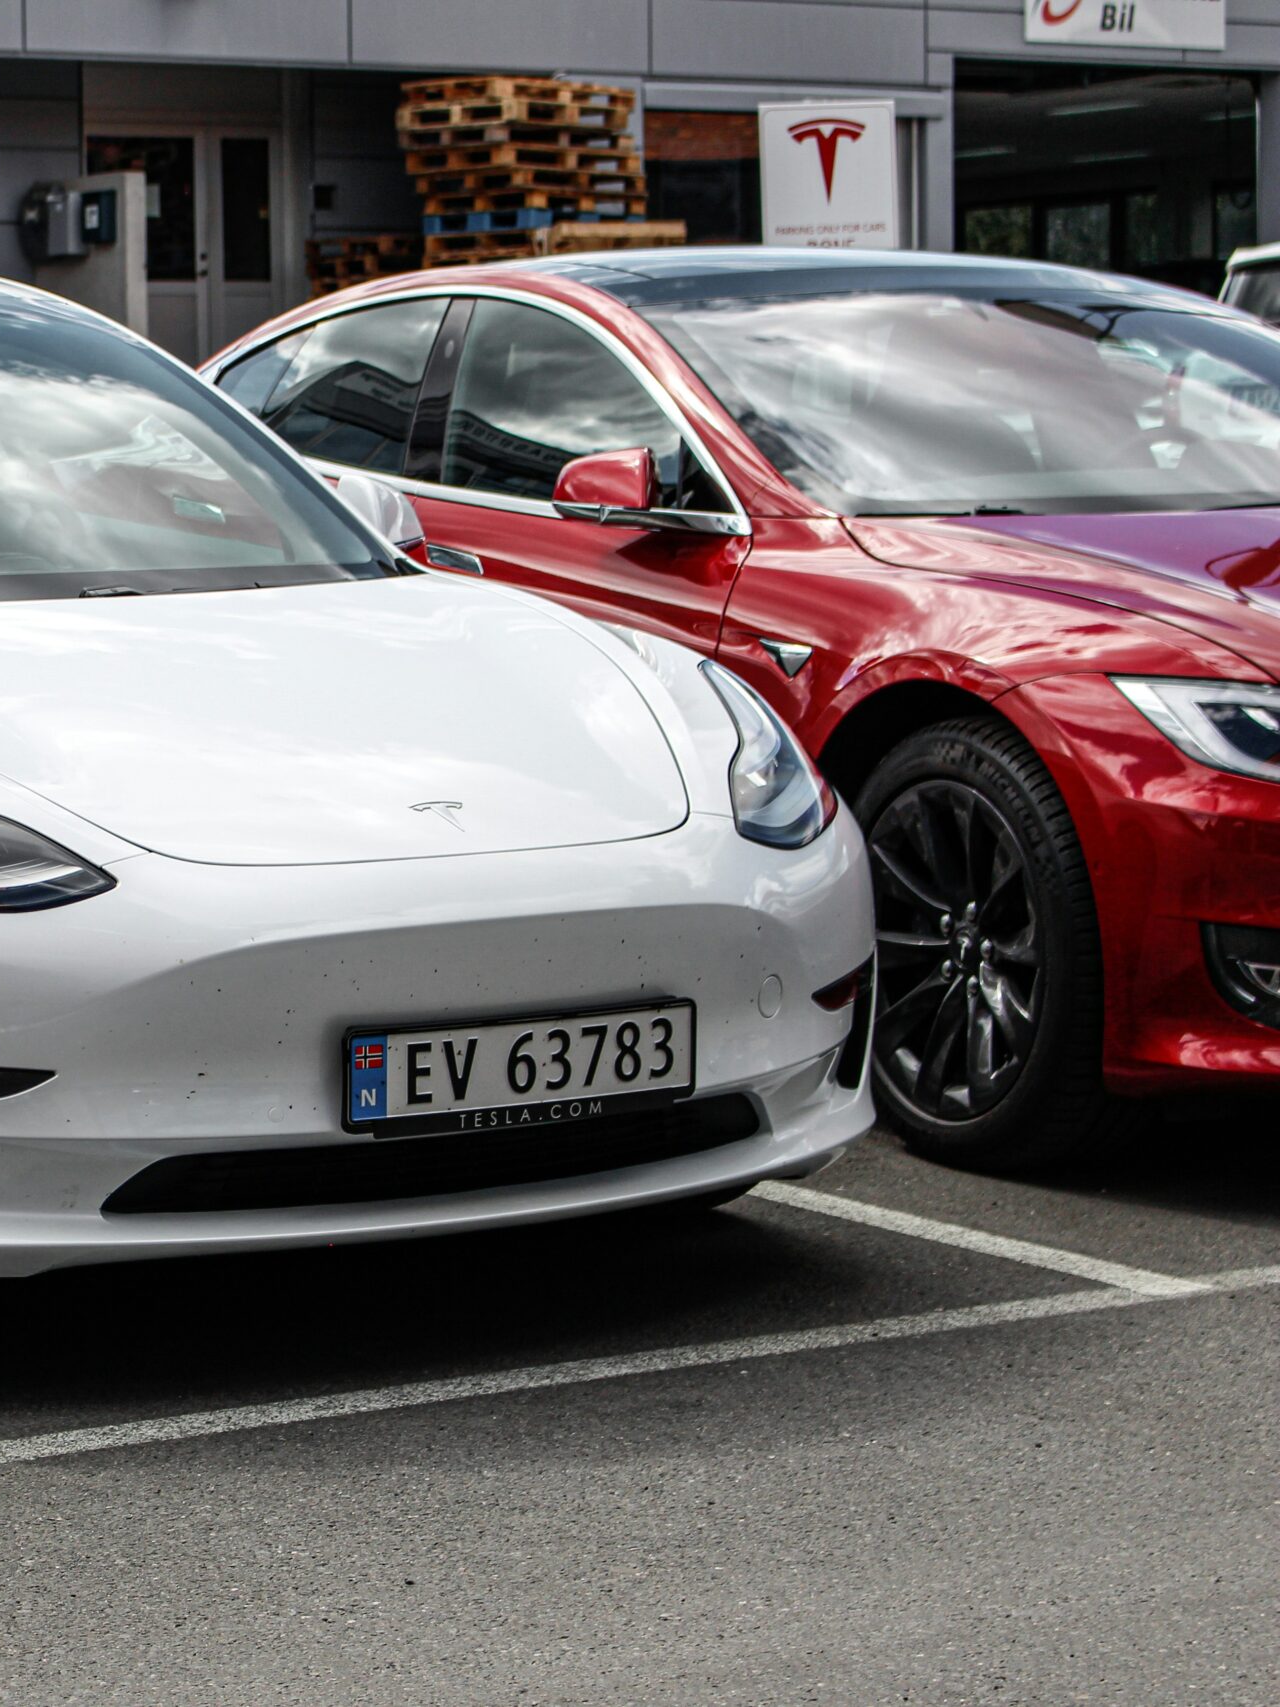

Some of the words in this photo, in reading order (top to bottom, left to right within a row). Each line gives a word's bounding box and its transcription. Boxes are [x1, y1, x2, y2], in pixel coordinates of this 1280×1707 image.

[1101, 4, 1136, 32] Bil
[817, 224, 842, 235] ONLY
[843, 223, 862, 234] FOR
[864, 222, 888, 233] CARS
[979, 760, 1042, 844] MICHELIN
[406, 1037, 478, 1105] EV
[506, 1017, 675, 1095] 63783
[360, 1087, 377, 1108] N
[459, 1100, 603, 1129] TESLA.COM
